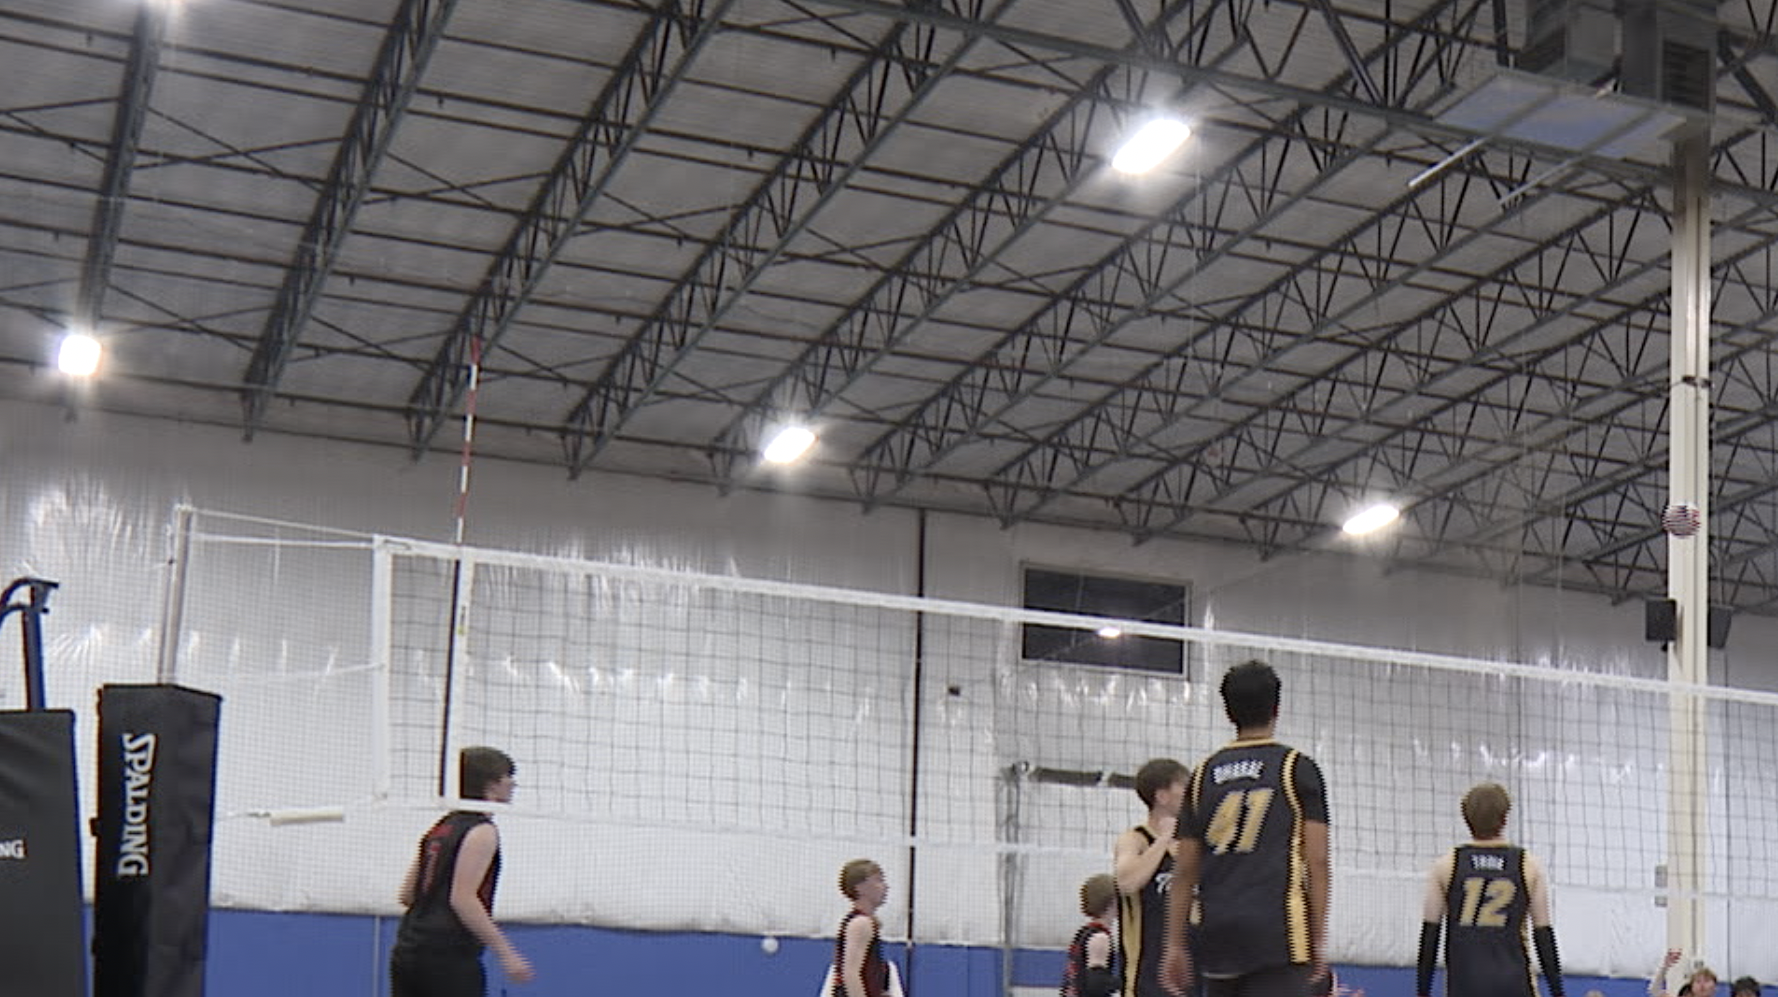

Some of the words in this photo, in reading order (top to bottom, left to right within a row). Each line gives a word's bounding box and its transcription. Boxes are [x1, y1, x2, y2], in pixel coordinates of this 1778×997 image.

[117, 733, 156, 876] SPALDING
[1204, 788, 1274, 856] 41
[1460, 877, 1517, 926] 12
